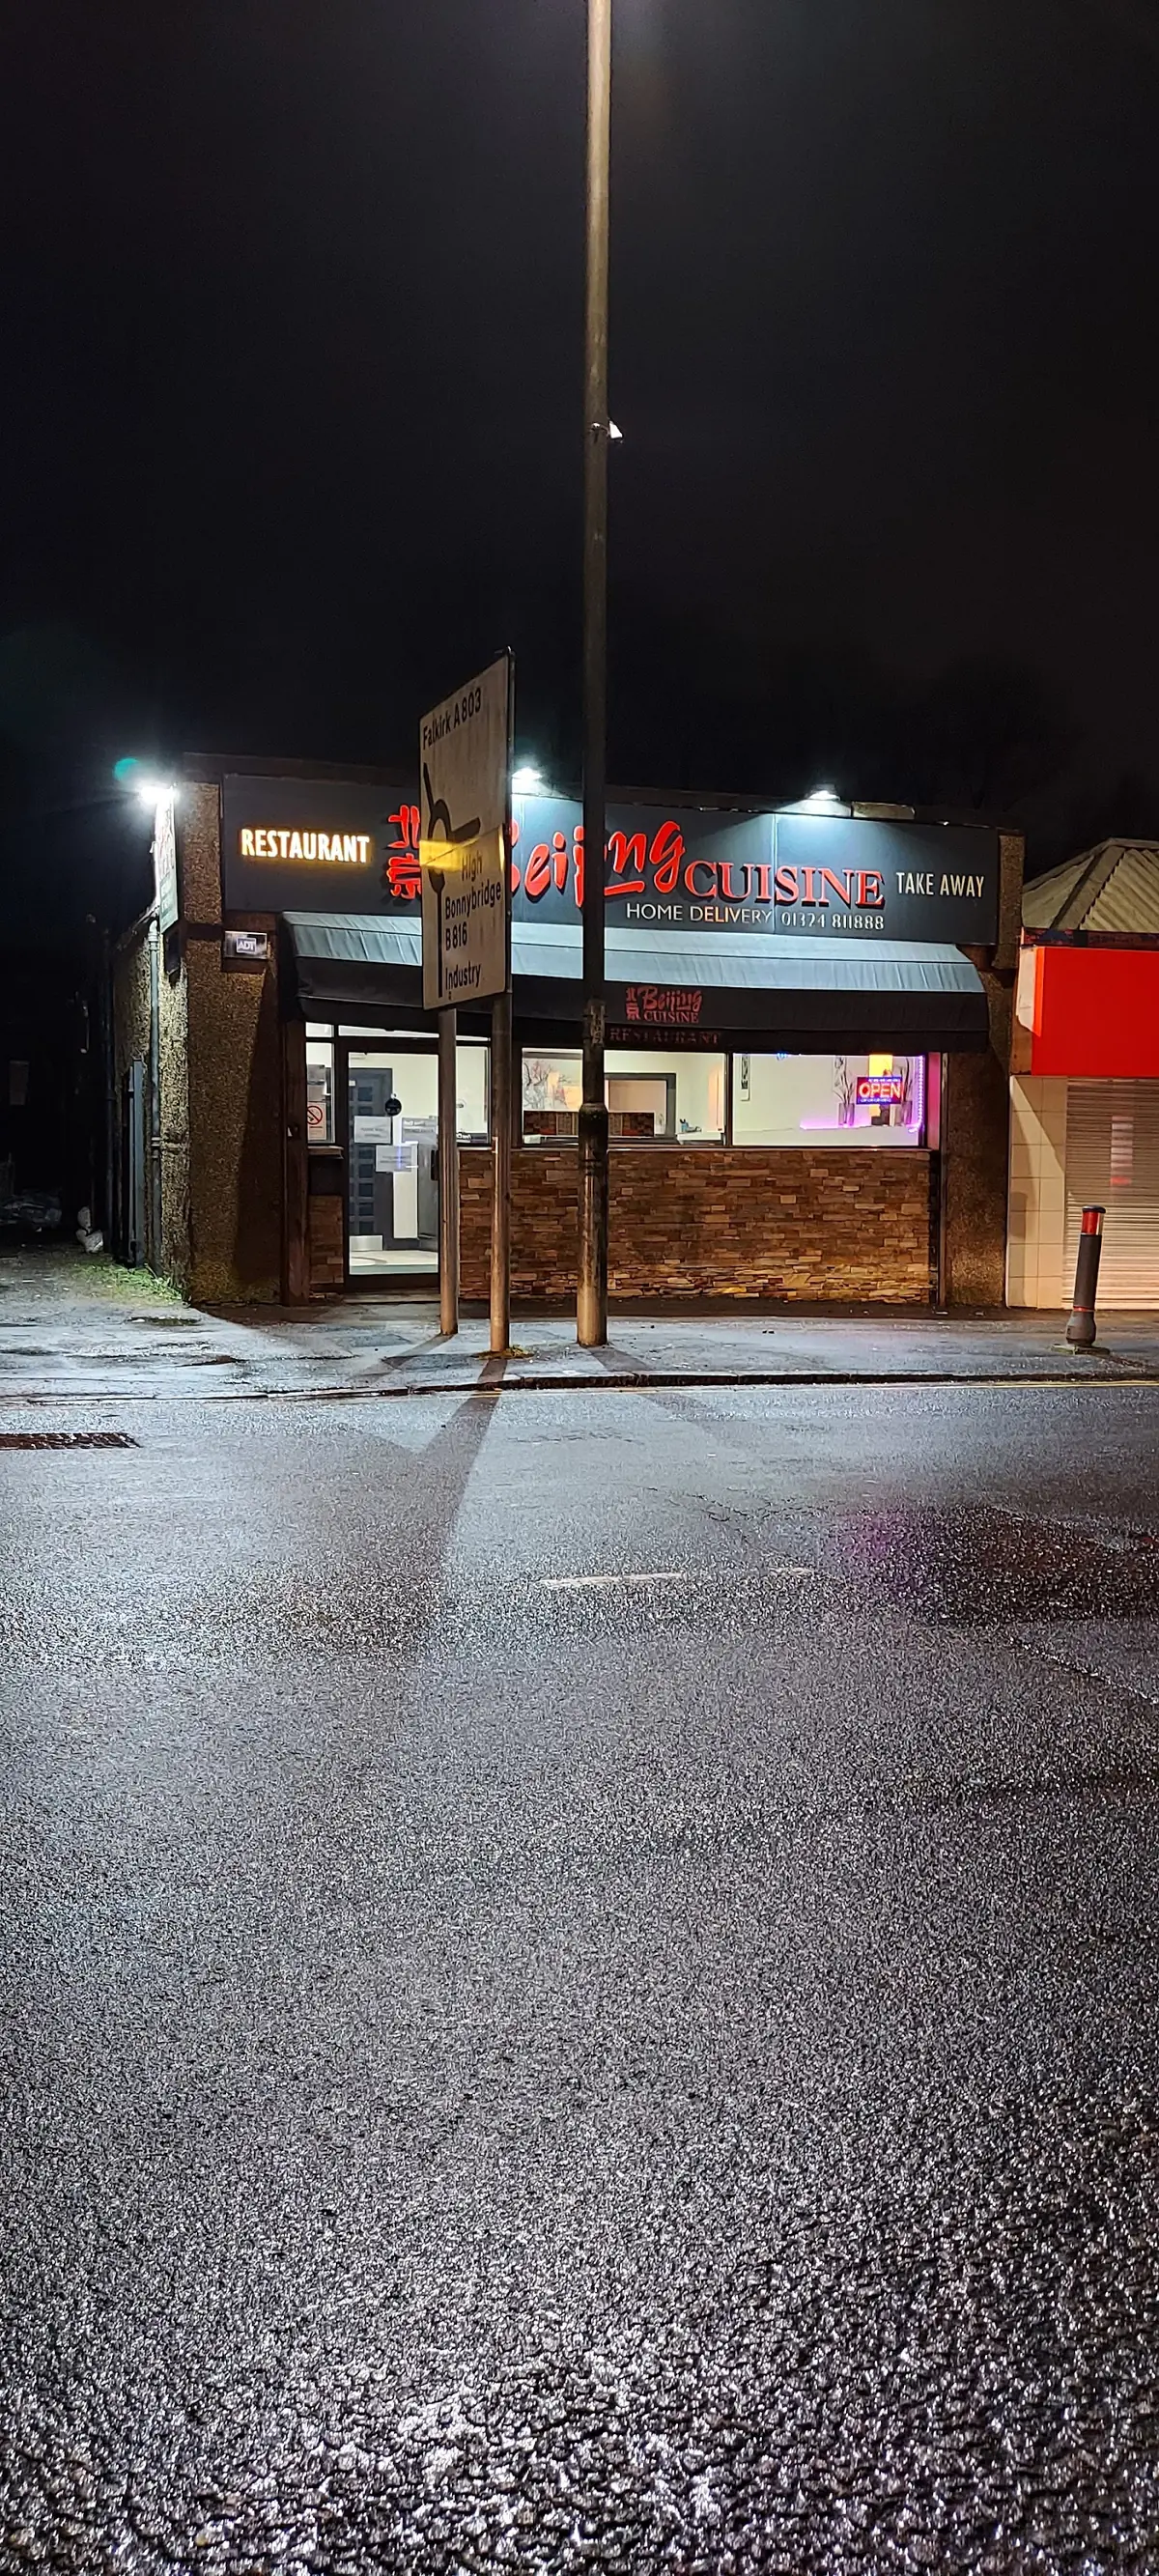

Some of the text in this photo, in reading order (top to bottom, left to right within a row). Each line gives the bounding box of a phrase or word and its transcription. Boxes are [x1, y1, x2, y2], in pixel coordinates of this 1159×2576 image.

[422, 711, 451, 750] Falkirk
[241, 828, 371, 863] RESTAURANT
[462, 849, 483, 882] High
[512, 819, 885, 908] eijng CUISINE
[896, 871, 984, 898] TAKE AWAY
[445, 880, 502, 920] Bonnybridge
[626, 902, 885, 930] HOME DELIVERY 01324 811888
[238, 940, 256, 951] ADT
[445, 960, 482, 991] Industry
[637, 985, 703, 1012] Beijing
[643, 1010, 699, 1024] CUISINE
[859, 1082, 901, 1099] OPEN
